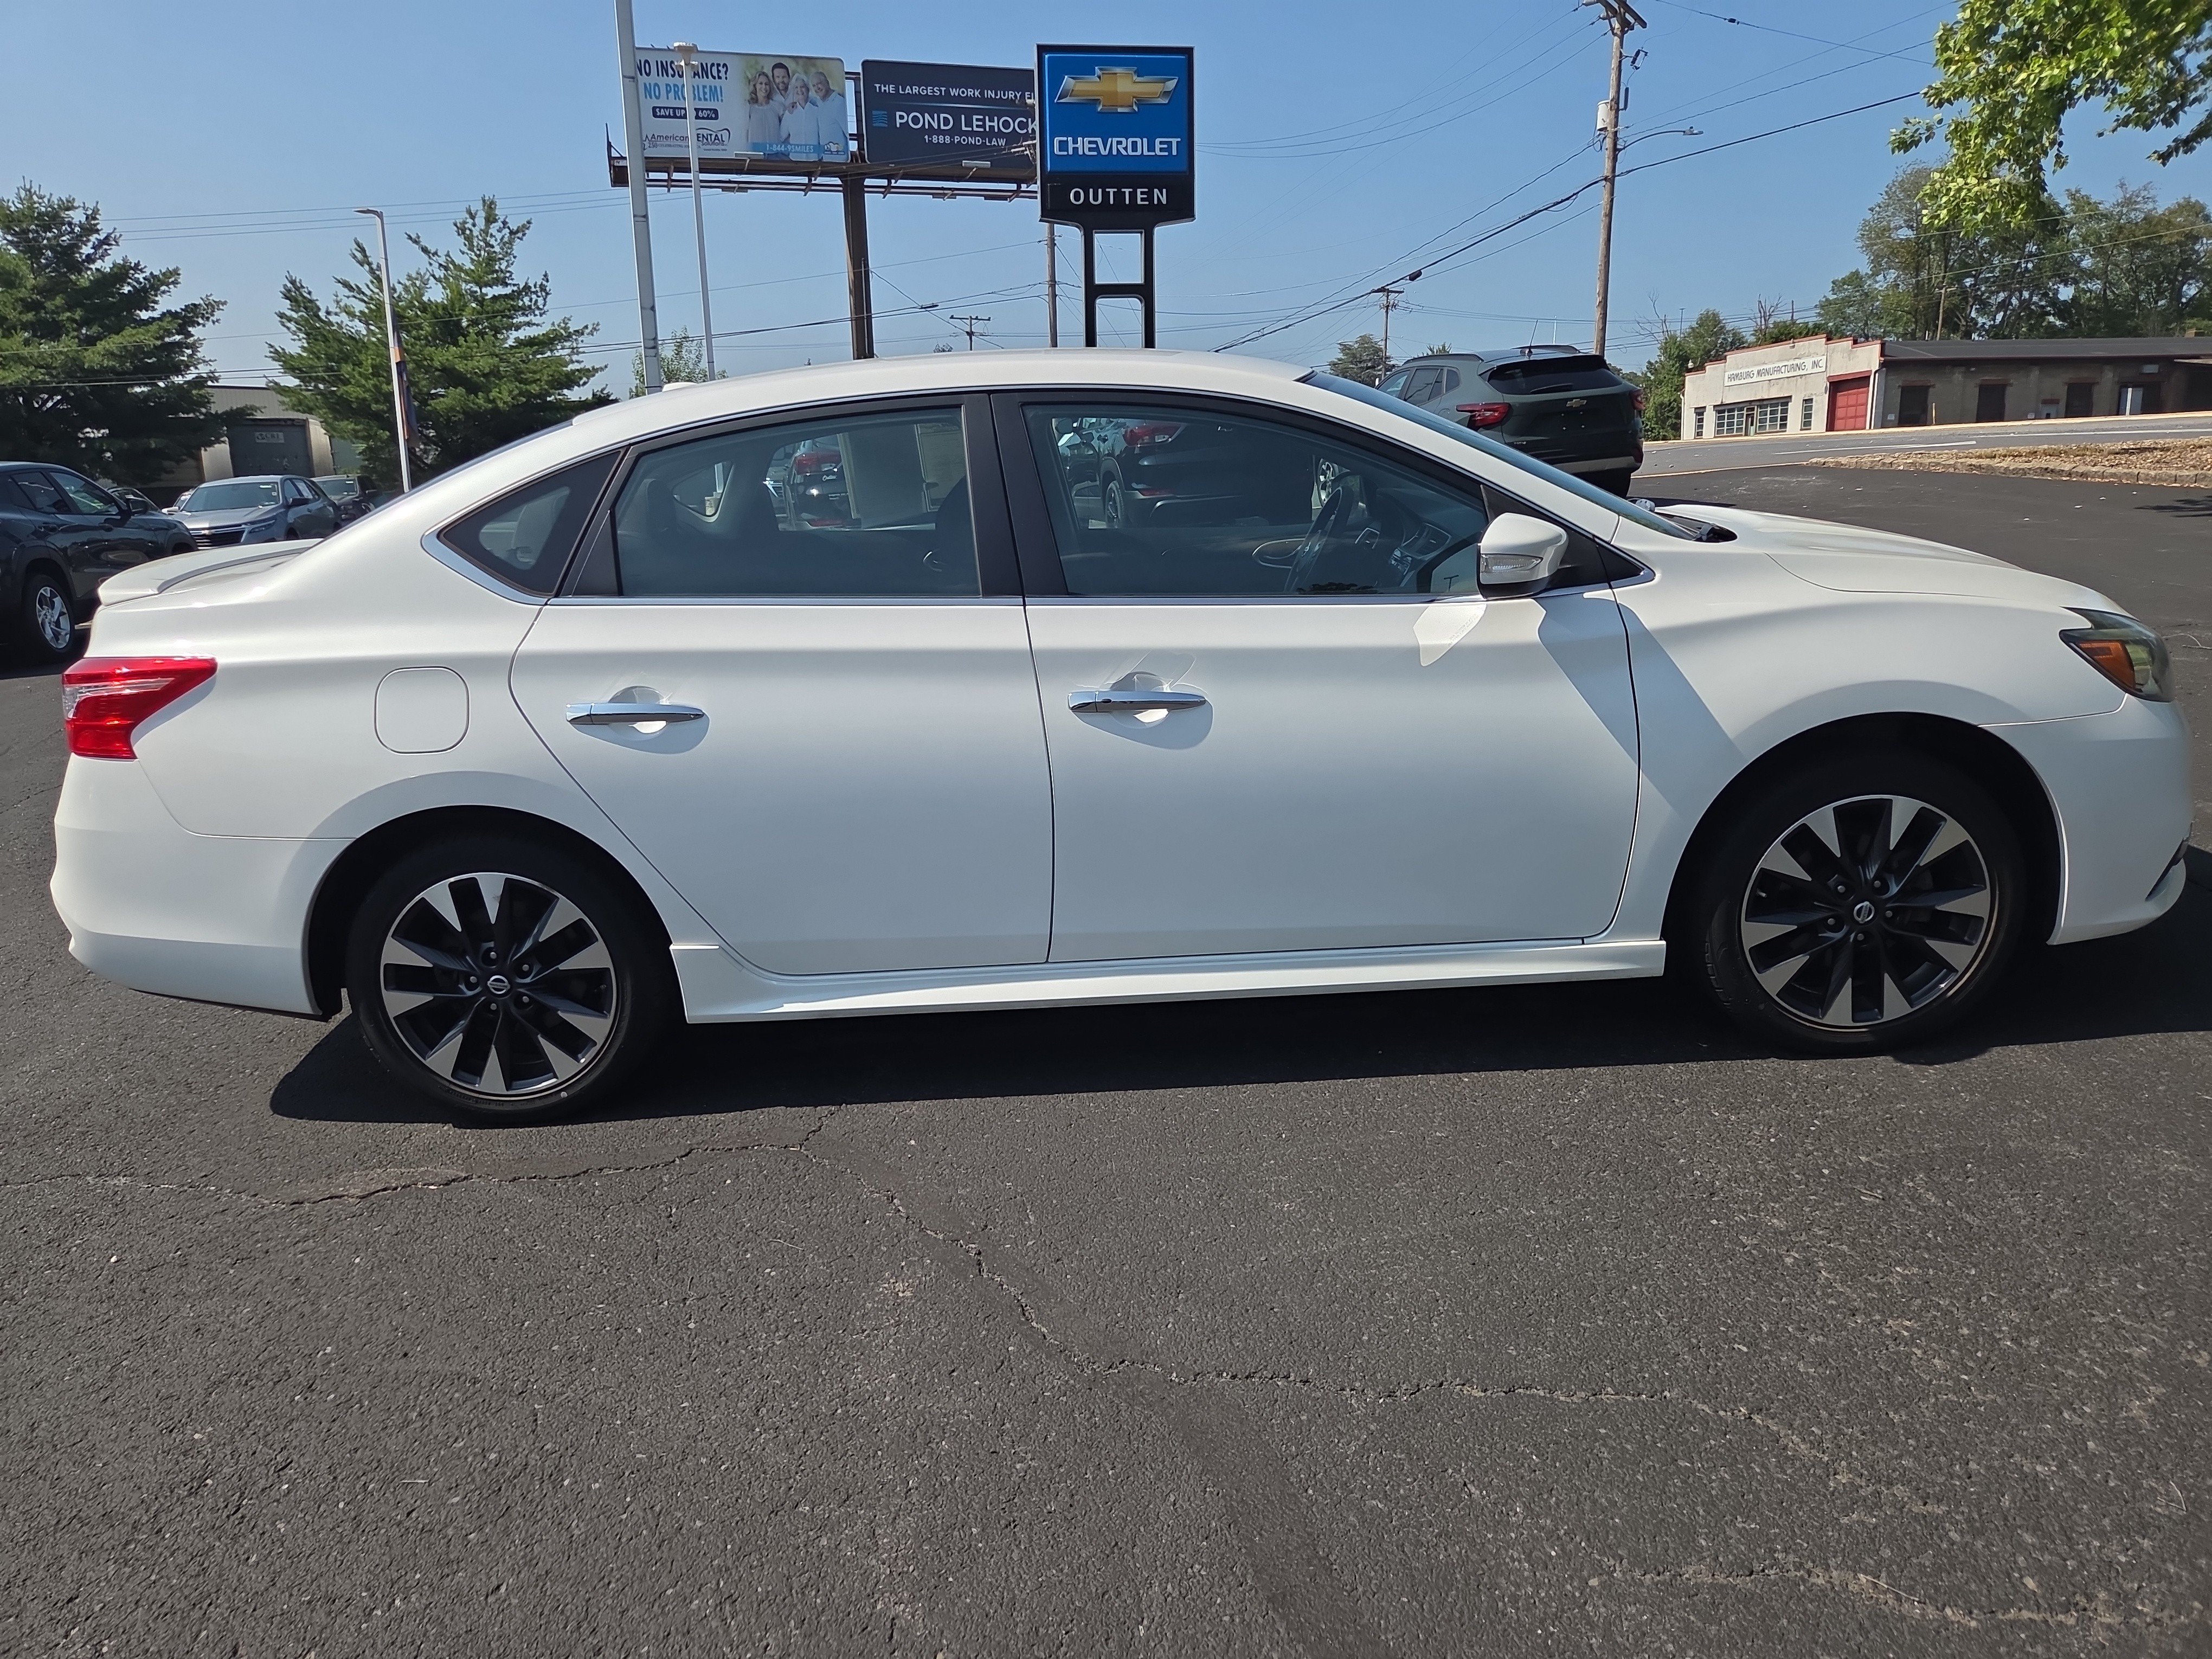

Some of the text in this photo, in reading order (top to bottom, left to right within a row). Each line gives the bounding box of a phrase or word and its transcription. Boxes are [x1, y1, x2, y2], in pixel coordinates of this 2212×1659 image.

[636, 59, 651, 77] NO
[644, 82, 661, 100] NO
[874, 83, 896, 93] THE
[899, 85, 946, 96] LARGEST
[949, 87, 981, 98] WORK
[984, 89, 1022, 100] INJURY
[655, 108, 674, 117] SAVE
[675, 109, 686, 117] UP
[698, 110, 716, 118] 60%
[896, 111, 1036, 134] POND LEHOCK
[696, 133, 725, 142] ENTAL
[924, 134, 1006, 146] 1-888-POND-LAW
[766, 144, 814, 153] 1-844-9SMILES
[1054, 137, 1181, 156] CHEVROLET
[1070, 188, 1167, 205] OUTTEN
[1727, 370, 1754, 383] HAMBURG
